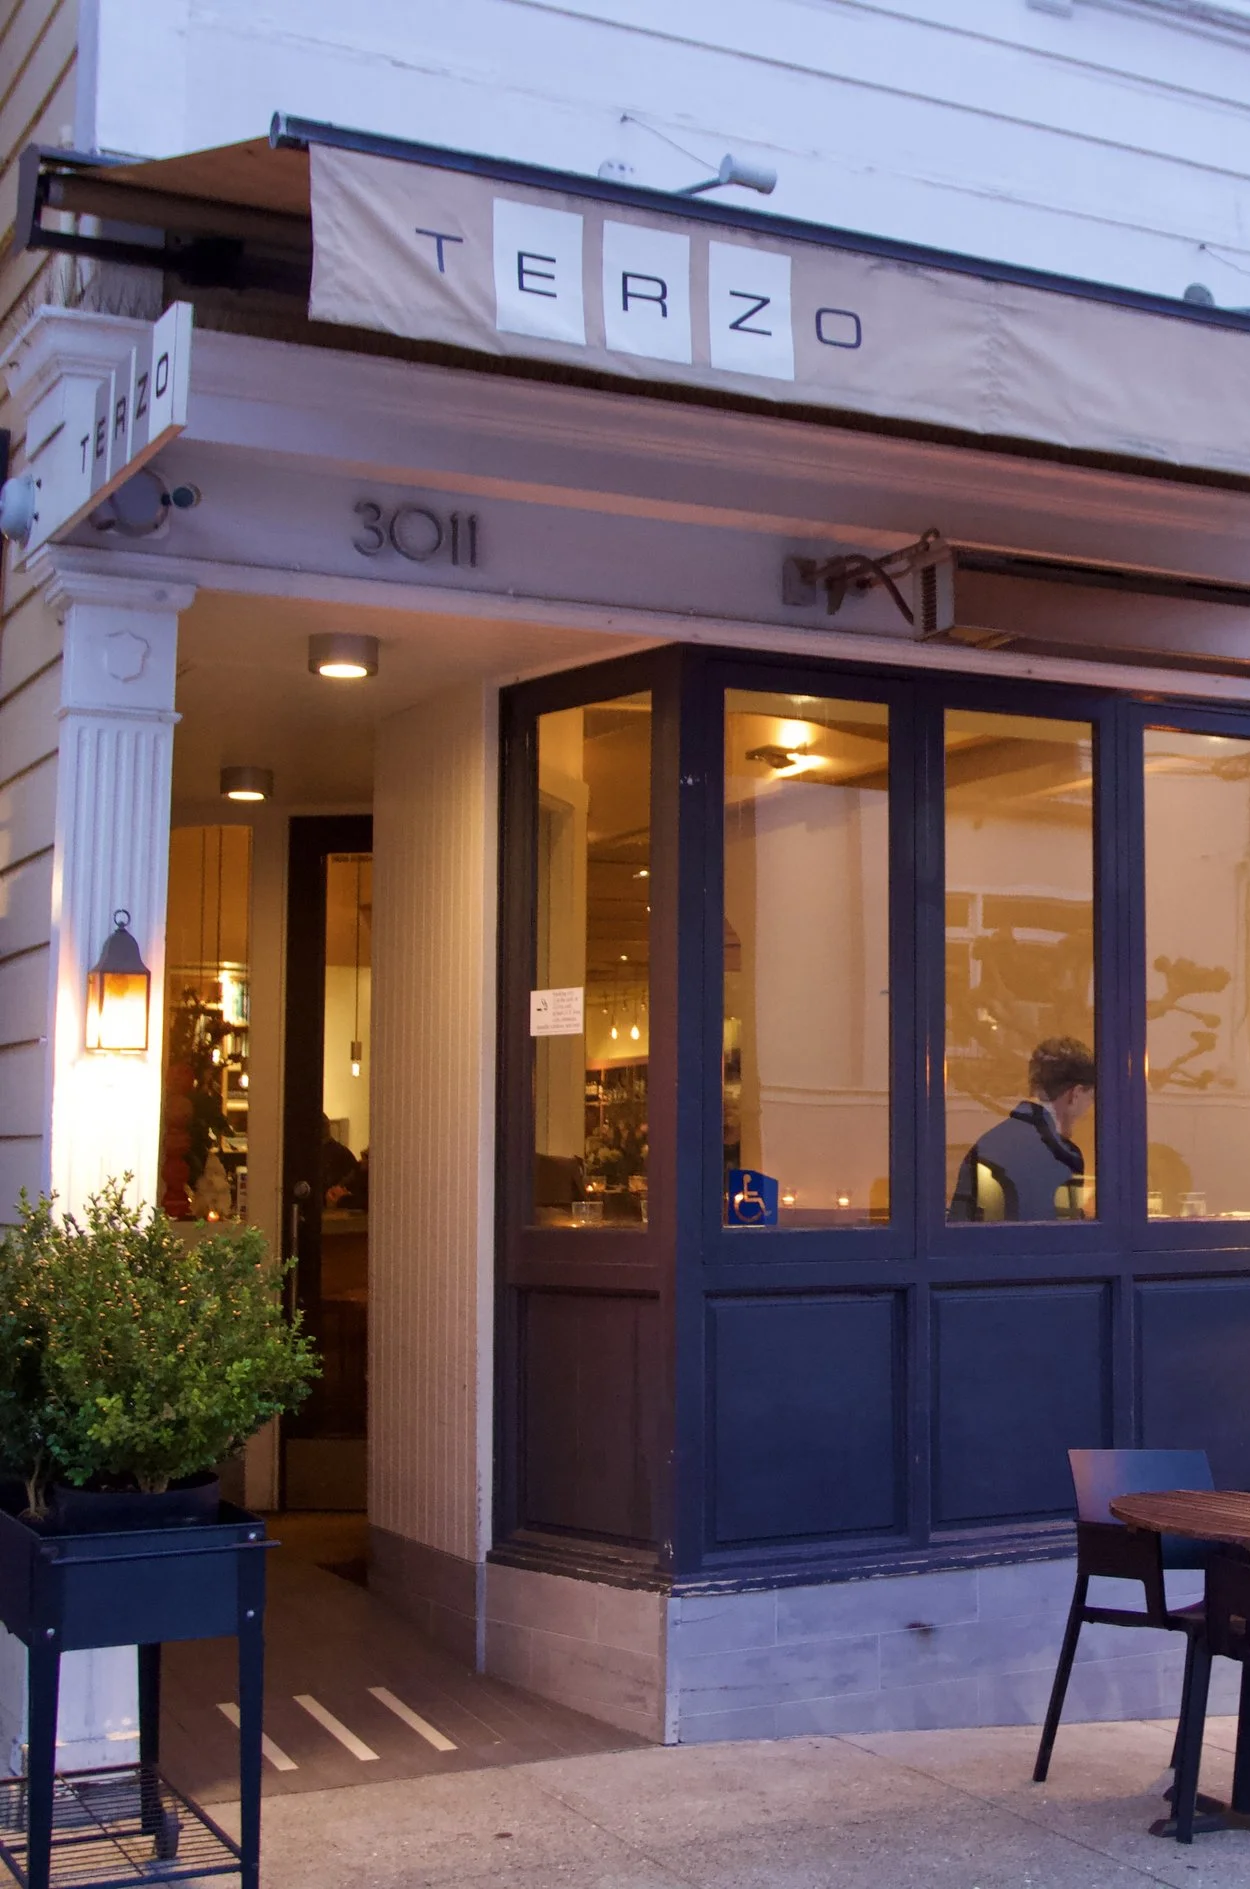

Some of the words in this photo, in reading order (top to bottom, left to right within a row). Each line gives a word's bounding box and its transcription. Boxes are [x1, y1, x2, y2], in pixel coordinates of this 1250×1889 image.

[414, 227, 863, 350] TERZO
[80, 351, 169, 474] TERZO
[353, 501, 478, 568] 3011
